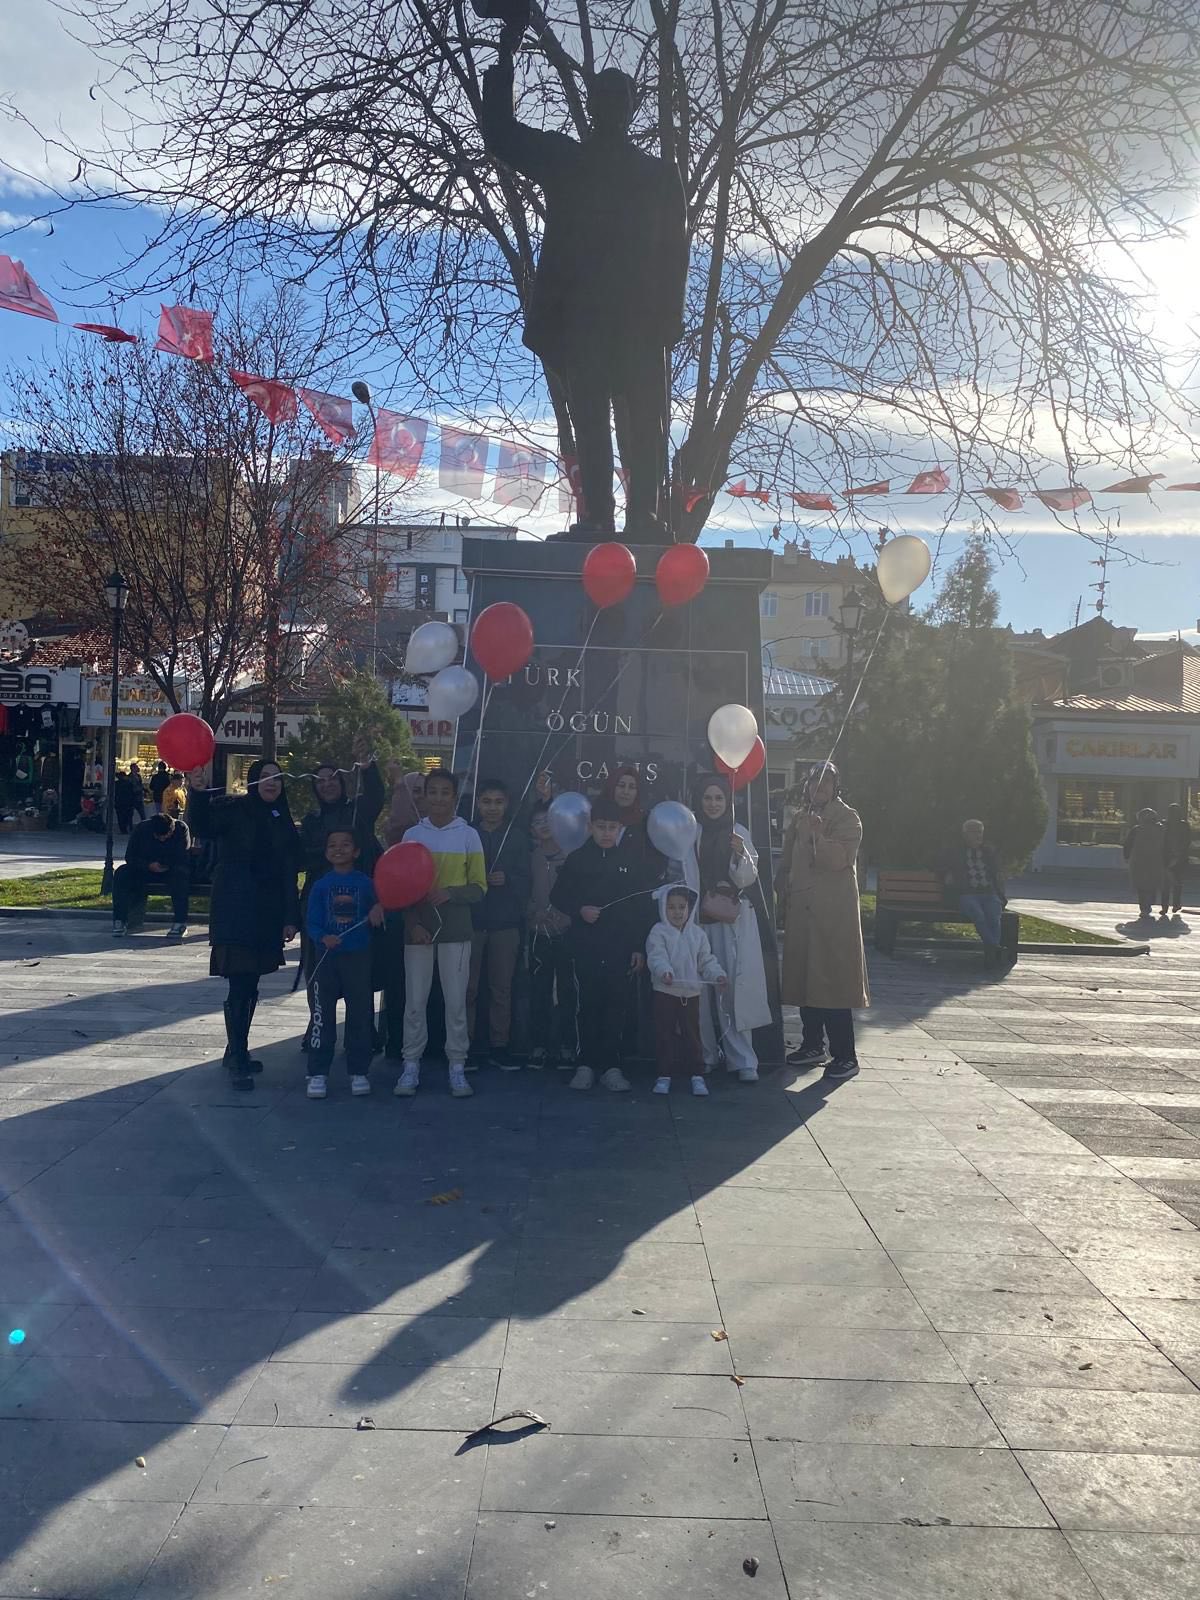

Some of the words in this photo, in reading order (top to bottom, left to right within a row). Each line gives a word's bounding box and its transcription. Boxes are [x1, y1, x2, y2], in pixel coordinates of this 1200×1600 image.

[507, 664, 582, 687] ÜRK
[224, 720, 288, 738] AHMT
[547, 709, 632, 733] ÖĞÜN
[576, 761, 658, 784] ÇAIŞ
[311, 981, 324, 1048] adidas
